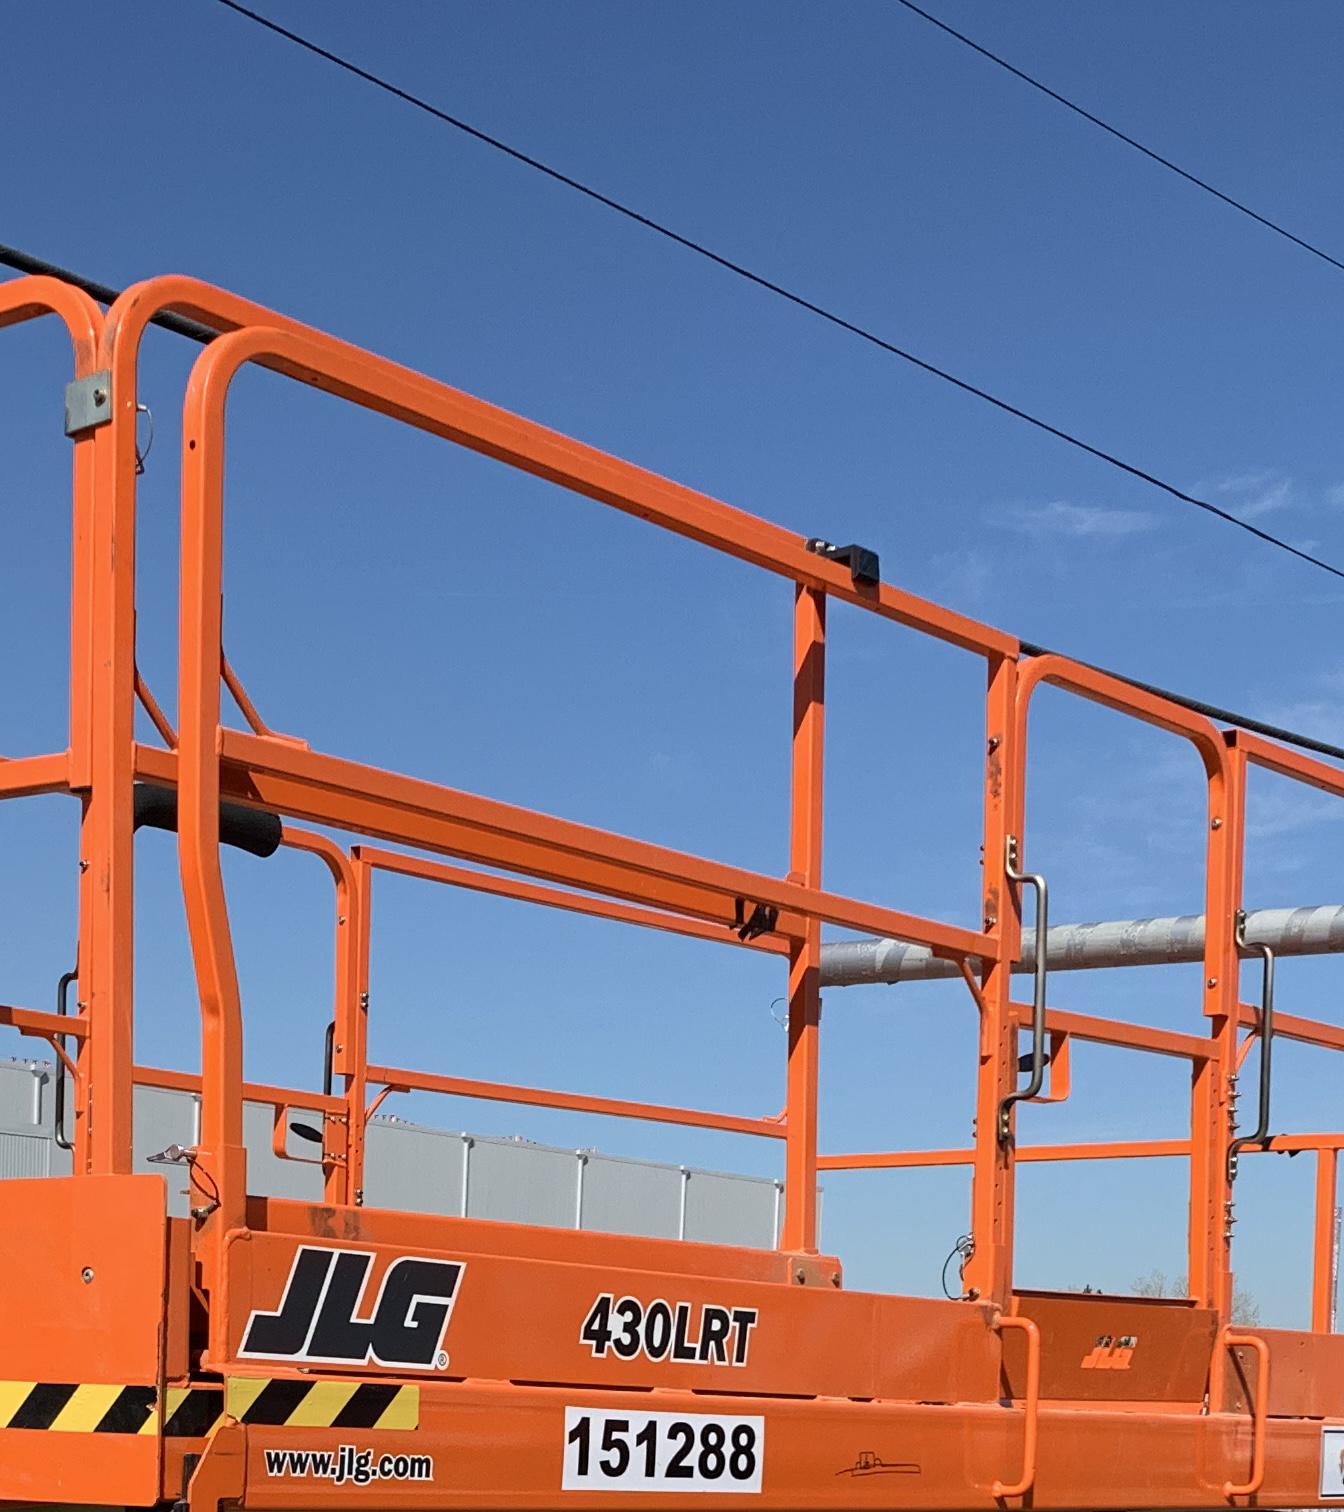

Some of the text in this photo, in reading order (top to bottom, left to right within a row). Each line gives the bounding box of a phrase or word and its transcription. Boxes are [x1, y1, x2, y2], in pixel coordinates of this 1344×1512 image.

[241, 1246, 465, 1368] JLG
[582, 1294, 757, 1366] 430LRT
[265, 1446, 434, 1485] www.jlg.com
[567, 1416, 757, 1481] 151288
